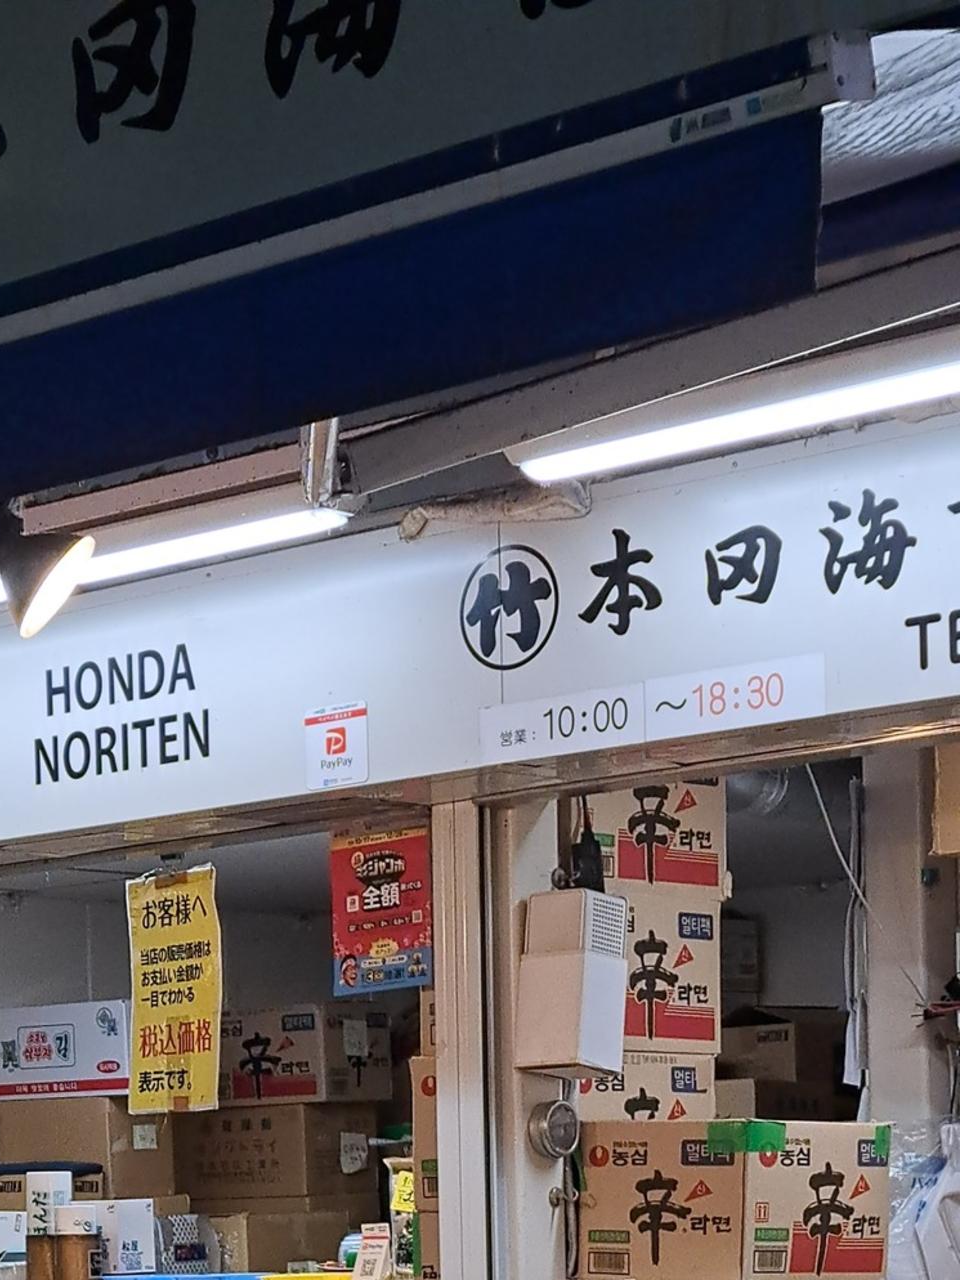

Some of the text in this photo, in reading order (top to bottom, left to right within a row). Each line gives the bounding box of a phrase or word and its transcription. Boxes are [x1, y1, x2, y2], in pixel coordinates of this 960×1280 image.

[45, 643, 196, 716] HONDA
[543, 698, 628, 740] 10:00
[34, 709, 209, 785] NORITEN
[320, 755, 353, 770] PayPay
[362, 881, 401, 911] 全額
[141, 897, 208, 930] お客様へ
[141, 986, 195, 1008] 一目でわかる
[139, 1018, 212, 1058] 税込価格
[138, 1069, 193, 1094] 表示です。
[612, 1148, 648, 1167] 농심
[780, 1147, 811, 1167] 농심
[690, 1215, 732, 1235] 라면
[851, 1215, 881, 1238] 라면
